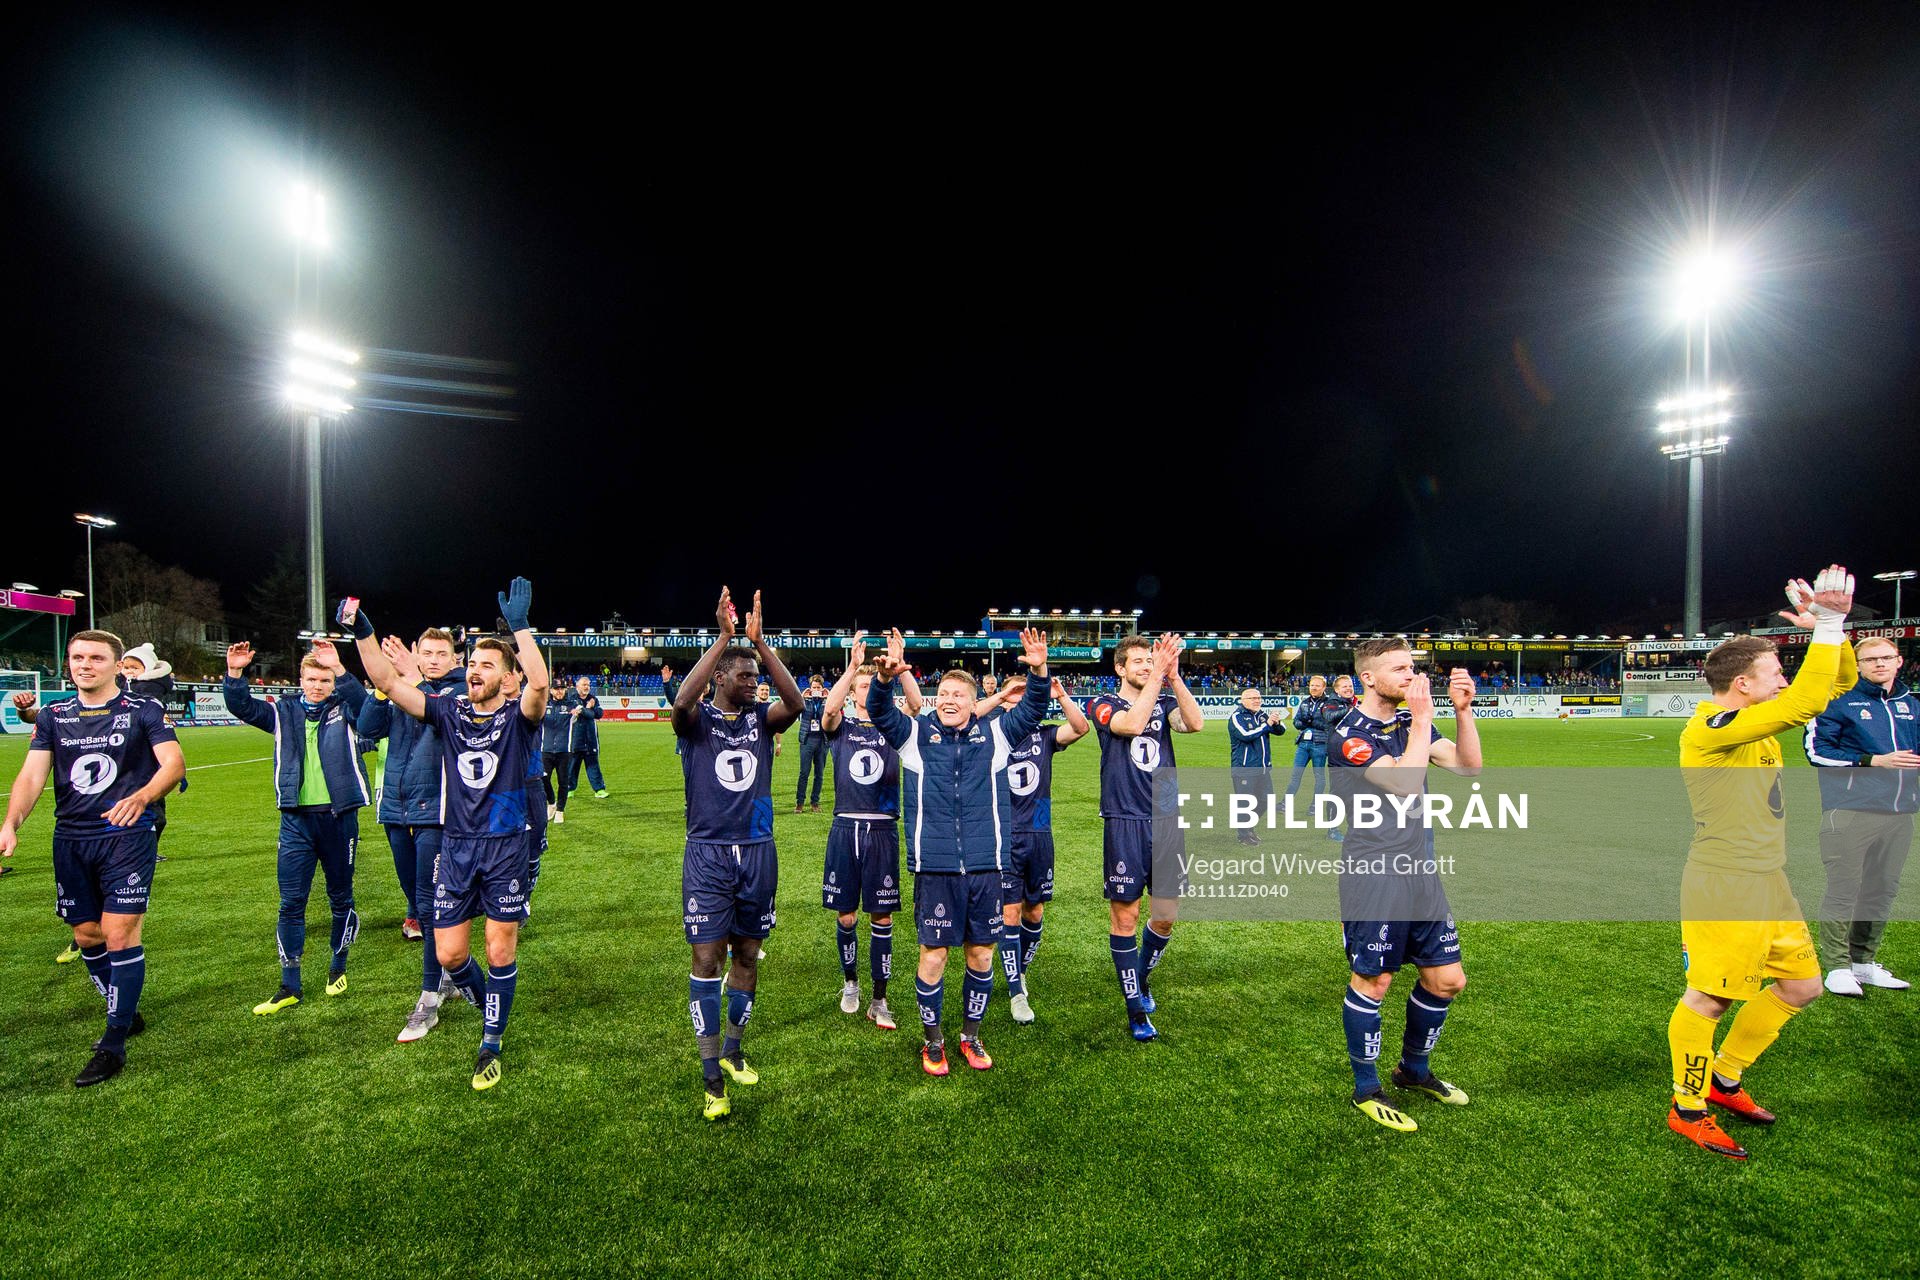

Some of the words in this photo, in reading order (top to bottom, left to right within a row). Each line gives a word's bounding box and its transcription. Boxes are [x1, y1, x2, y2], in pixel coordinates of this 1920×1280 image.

[576, 635, 614, 647] MØRE
[618, 635, 656, 647] DRIFT
[665, 636, 702, 647] MØRE
[1788, 634, 1812, 644] STR
[1856, 628, 1905, 641] STUBØ
[793, 636, 831, 648] DRIFT
[1640, 642, 1689, 650] TINGVOLL
[1626, 672, 1660, 680] Comfort
[1472, 708, 1514, 718] Nordea
[60, 734, 108, 747] SpareBank
[1109, 875, 1134, 884] olivita
[499, 895, 525, 904] olivita
[924, 919, 952, 928] olivita
[1002, 950, 1019, 982] NEAS
[1121, 968, 1139, 999] NEAS
[485, 993, 500, 1028] NEAS
